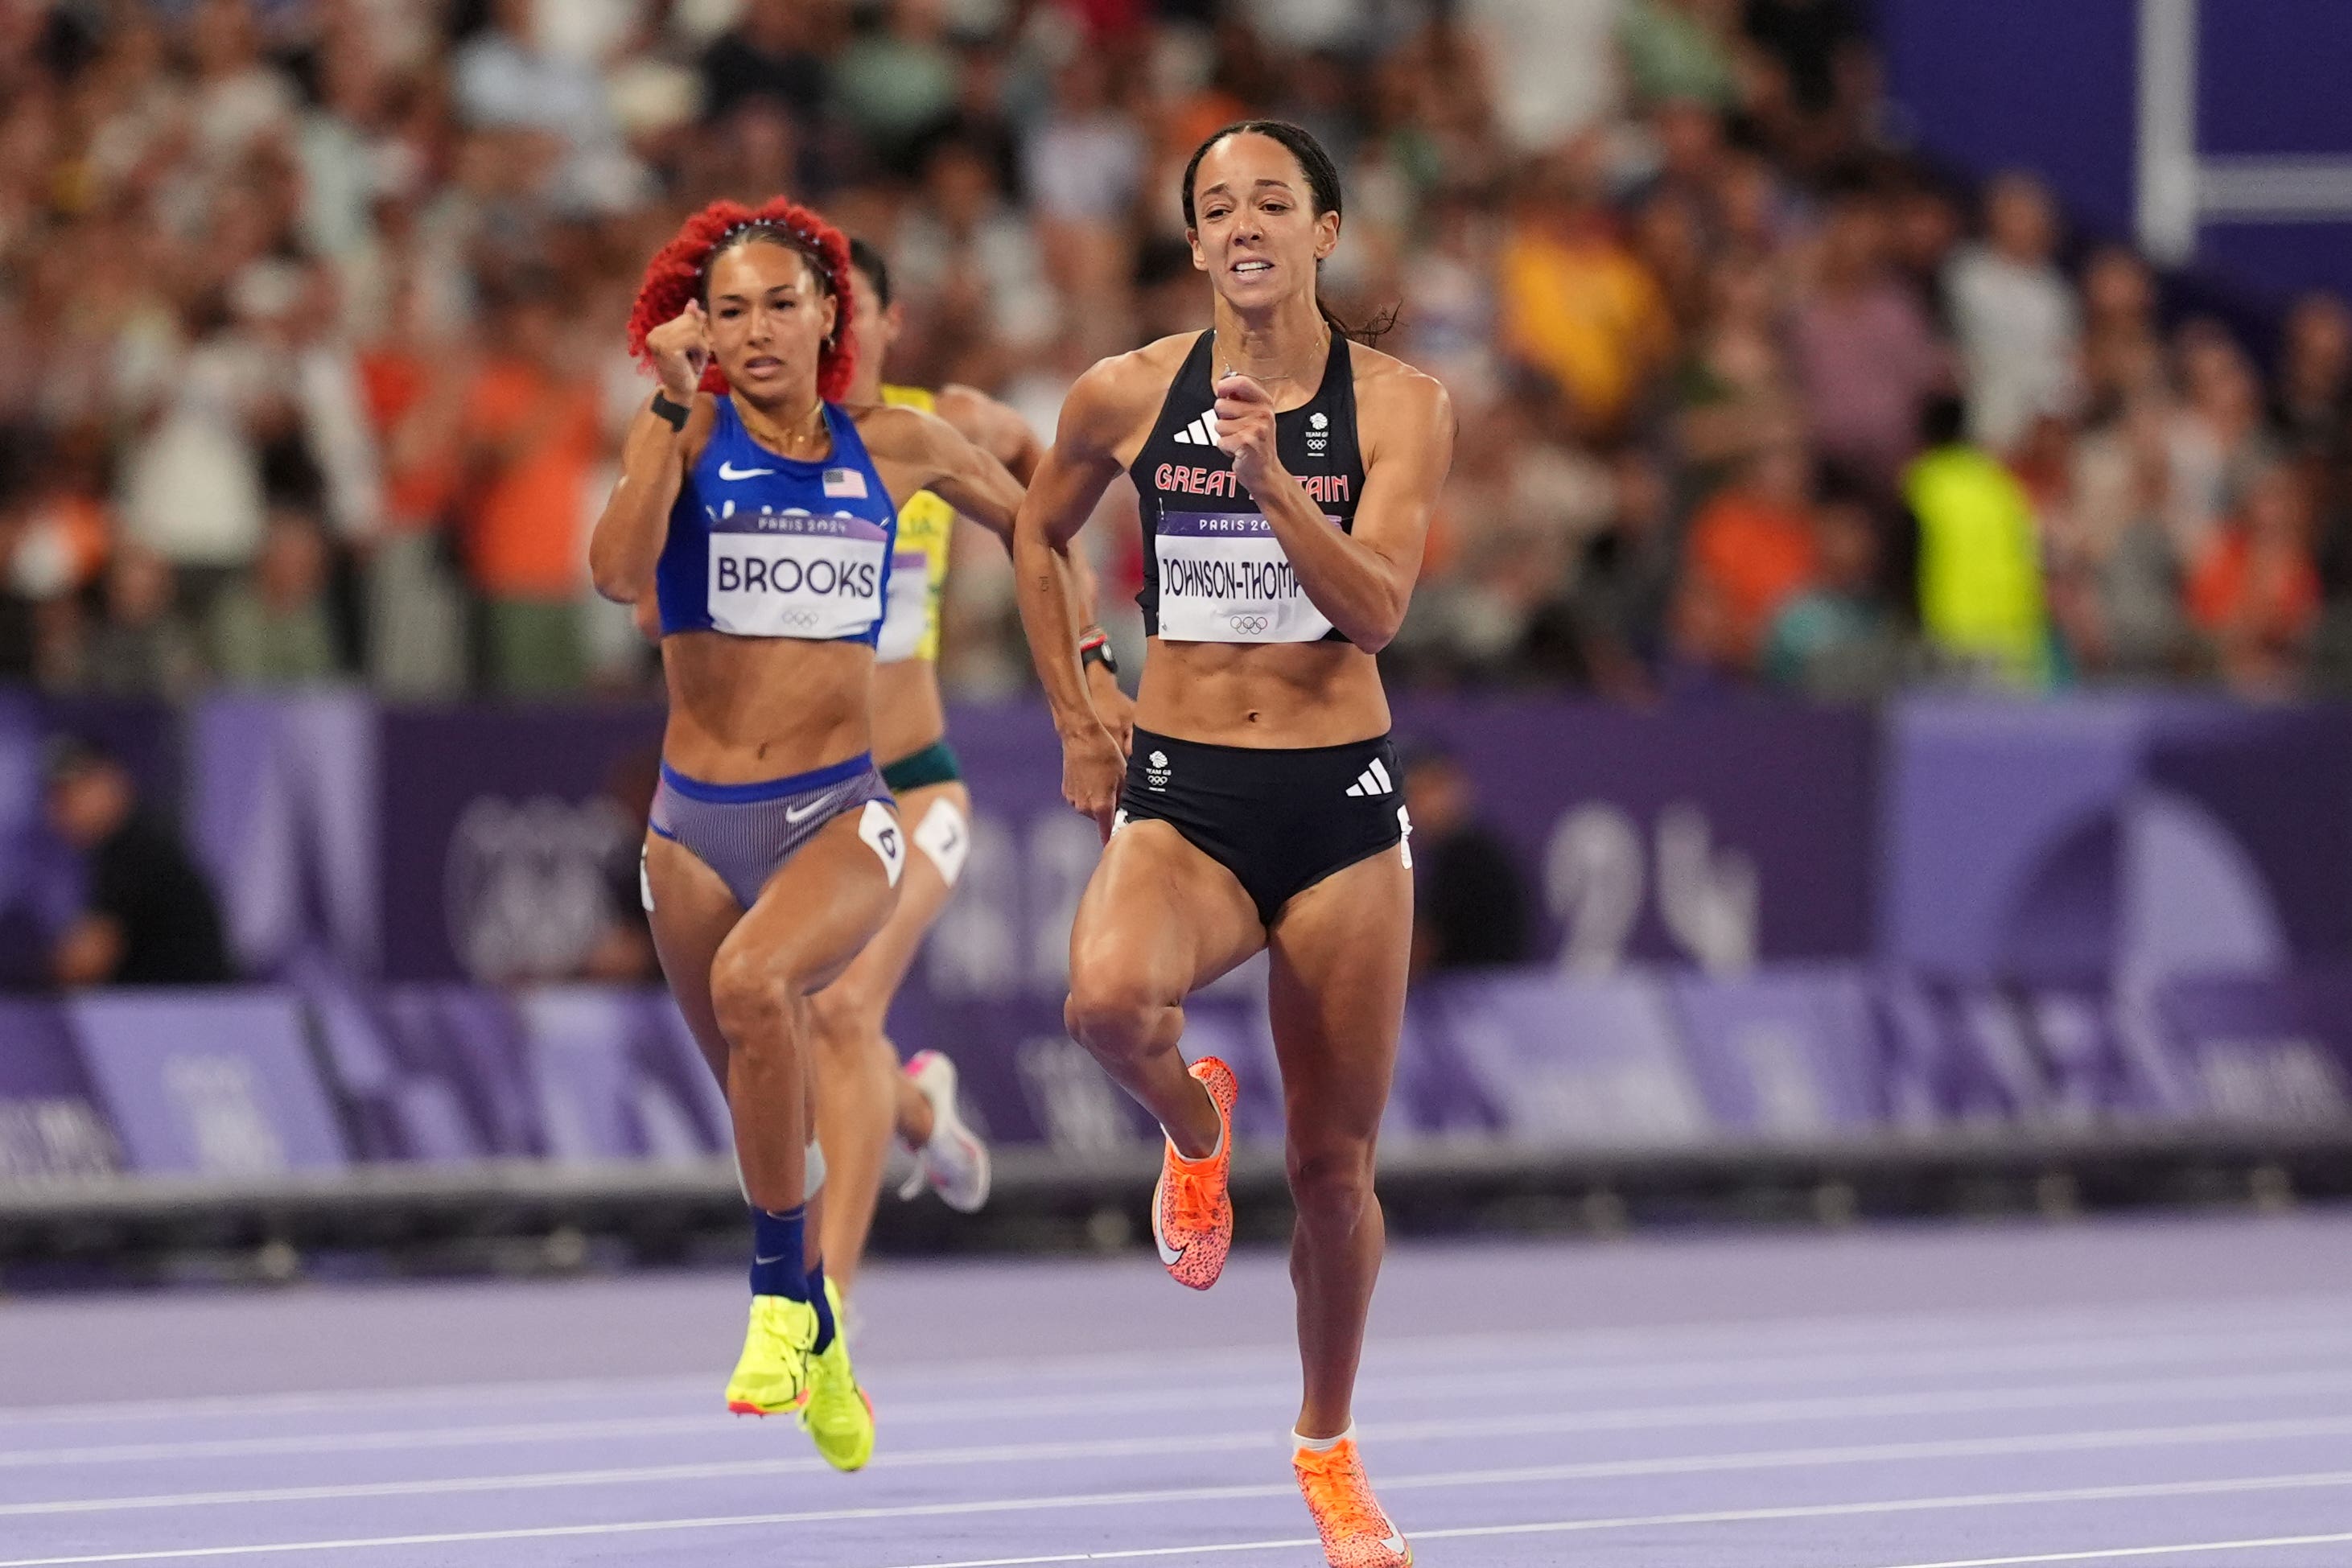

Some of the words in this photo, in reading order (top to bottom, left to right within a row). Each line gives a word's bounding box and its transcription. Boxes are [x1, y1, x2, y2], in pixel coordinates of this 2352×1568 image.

[1155, 463, 1238, 499] GREAT
[758, 517, 803, 532] PARIS
[807, 519, 846, 534] 2024
[1199, 519, 1246, 531] PARIS
[1250, 519, 1271, 532] 20
[719, 558, 875, 598] BROOKS
